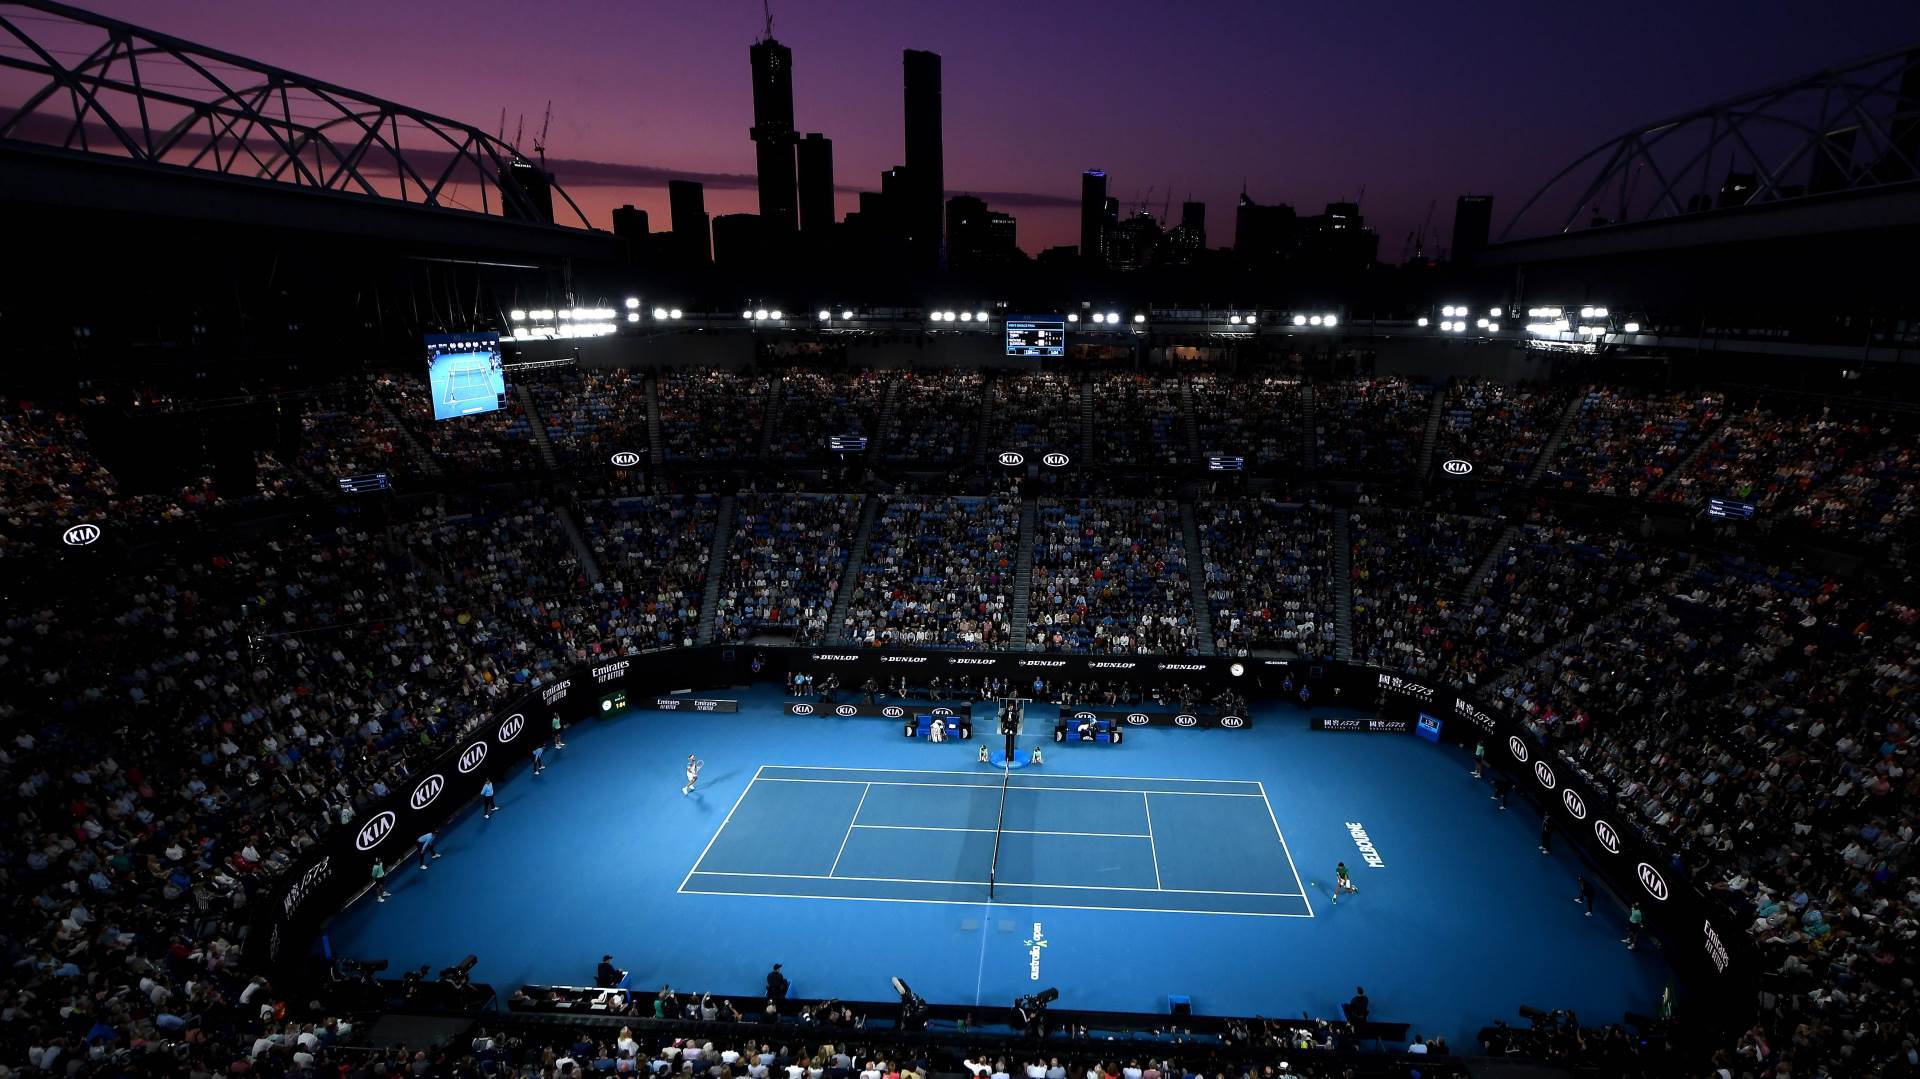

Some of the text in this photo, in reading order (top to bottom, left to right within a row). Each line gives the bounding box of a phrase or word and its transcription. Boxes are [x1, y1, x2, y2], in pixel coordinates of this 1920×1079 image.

[616, 455, 636, 464] KIA
[1002, 455, 1021, 464] KIA
[1047, 455, 1066, 464] KIA
[1448, 462, 1468, 472] KIA
[68, 527, 96, 543] KIA
[592, 660, 630, 677] Emirates
[1166, 663, 1207, 671] DUNLOP
[542, 679, 571, 700] Emirates
[795, 705, 811, 713] KIA
[839, 706, 854, 714] KIA
[886, 708, 900, 716] KIA
[1131, 715, 1145, 723] KIA
[1178, 716, 1193, 725] KIA
[1225, 717, 1239, 726] KIA
[501, 717, 521, 740] KIA
[1511, 738, 1525, 760] KIA
[462, 746, 484, 770] KIA
[1537, 763, 1552, 786] KIA
[415, 779, 440, 806] KIA
[1565, 791, 1582, 817] KIA
[362, 817, 391, 847] KIA
[1598, 822, 1616, 851] KIA
[1345, 822, 1385, 868] MELBOURNE
[1641, 865, 1663, 897] KIA
[1704, 919, 1729, 968] Emirates
